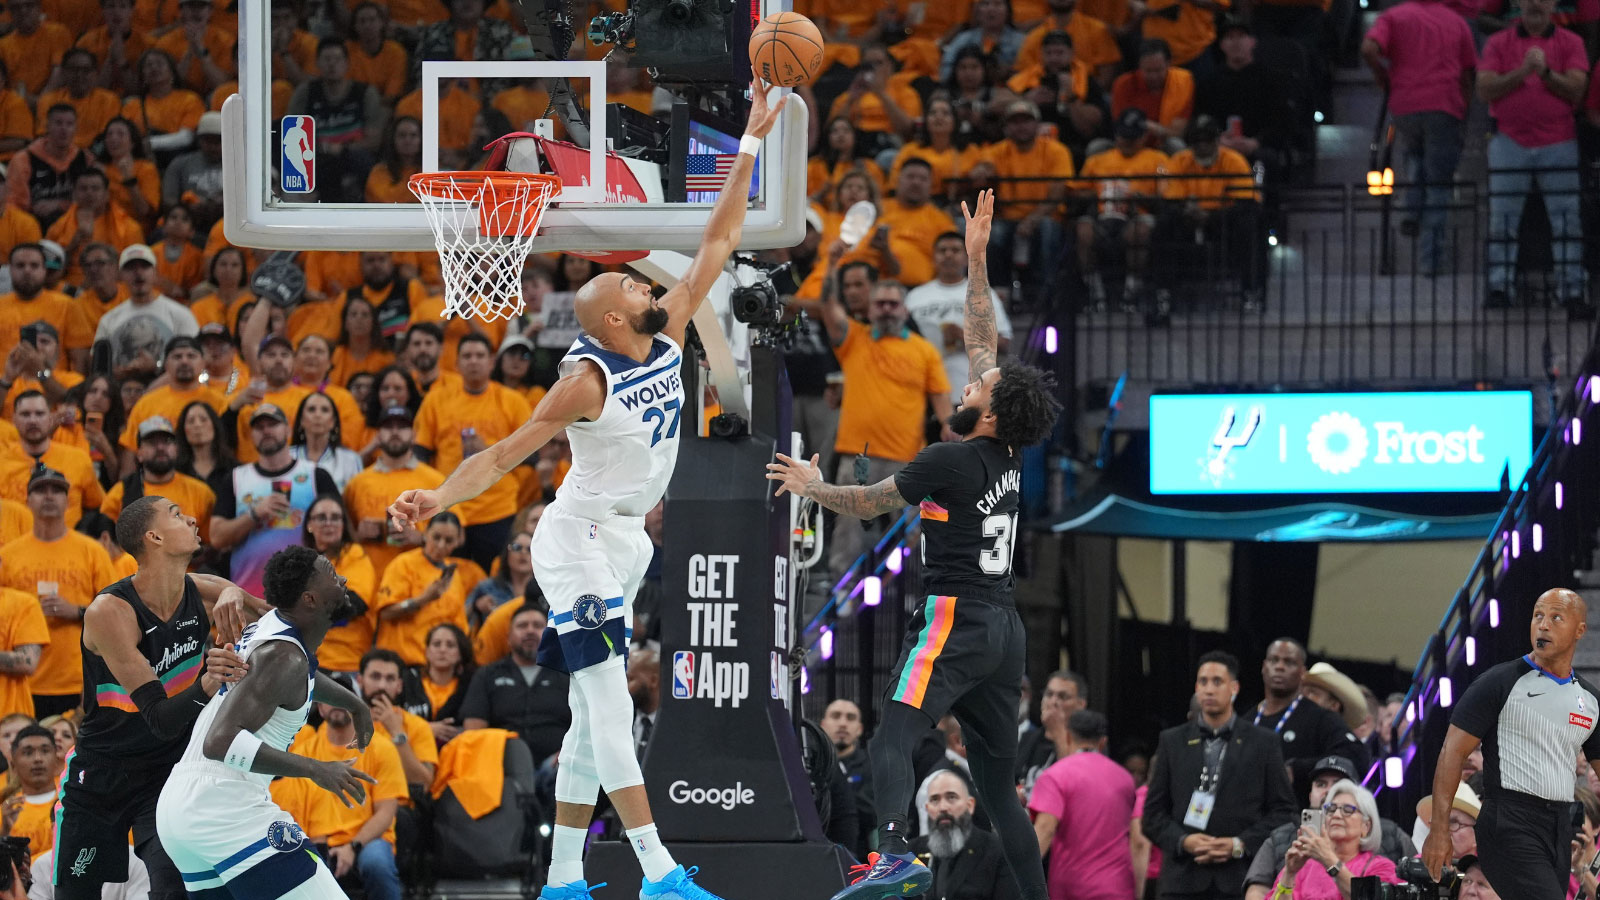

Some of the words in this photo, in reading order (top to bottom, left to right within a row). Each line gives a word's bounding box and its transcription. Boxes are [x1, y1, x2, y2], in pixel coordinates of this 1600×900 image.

[286, 175, 302, 188] NBA
[619, 371, 680, 412] WOLVES
[642, 397, 680, 448] 27
[1373, 422, 1485, 464] Frost
[688, 554, 739, 598] GET
[687, 603, 738, 647] THE
[160, 636, 199, 670] Antonio
[697, 652, 749, 708] App
[669, 780, 755, 810] Google
